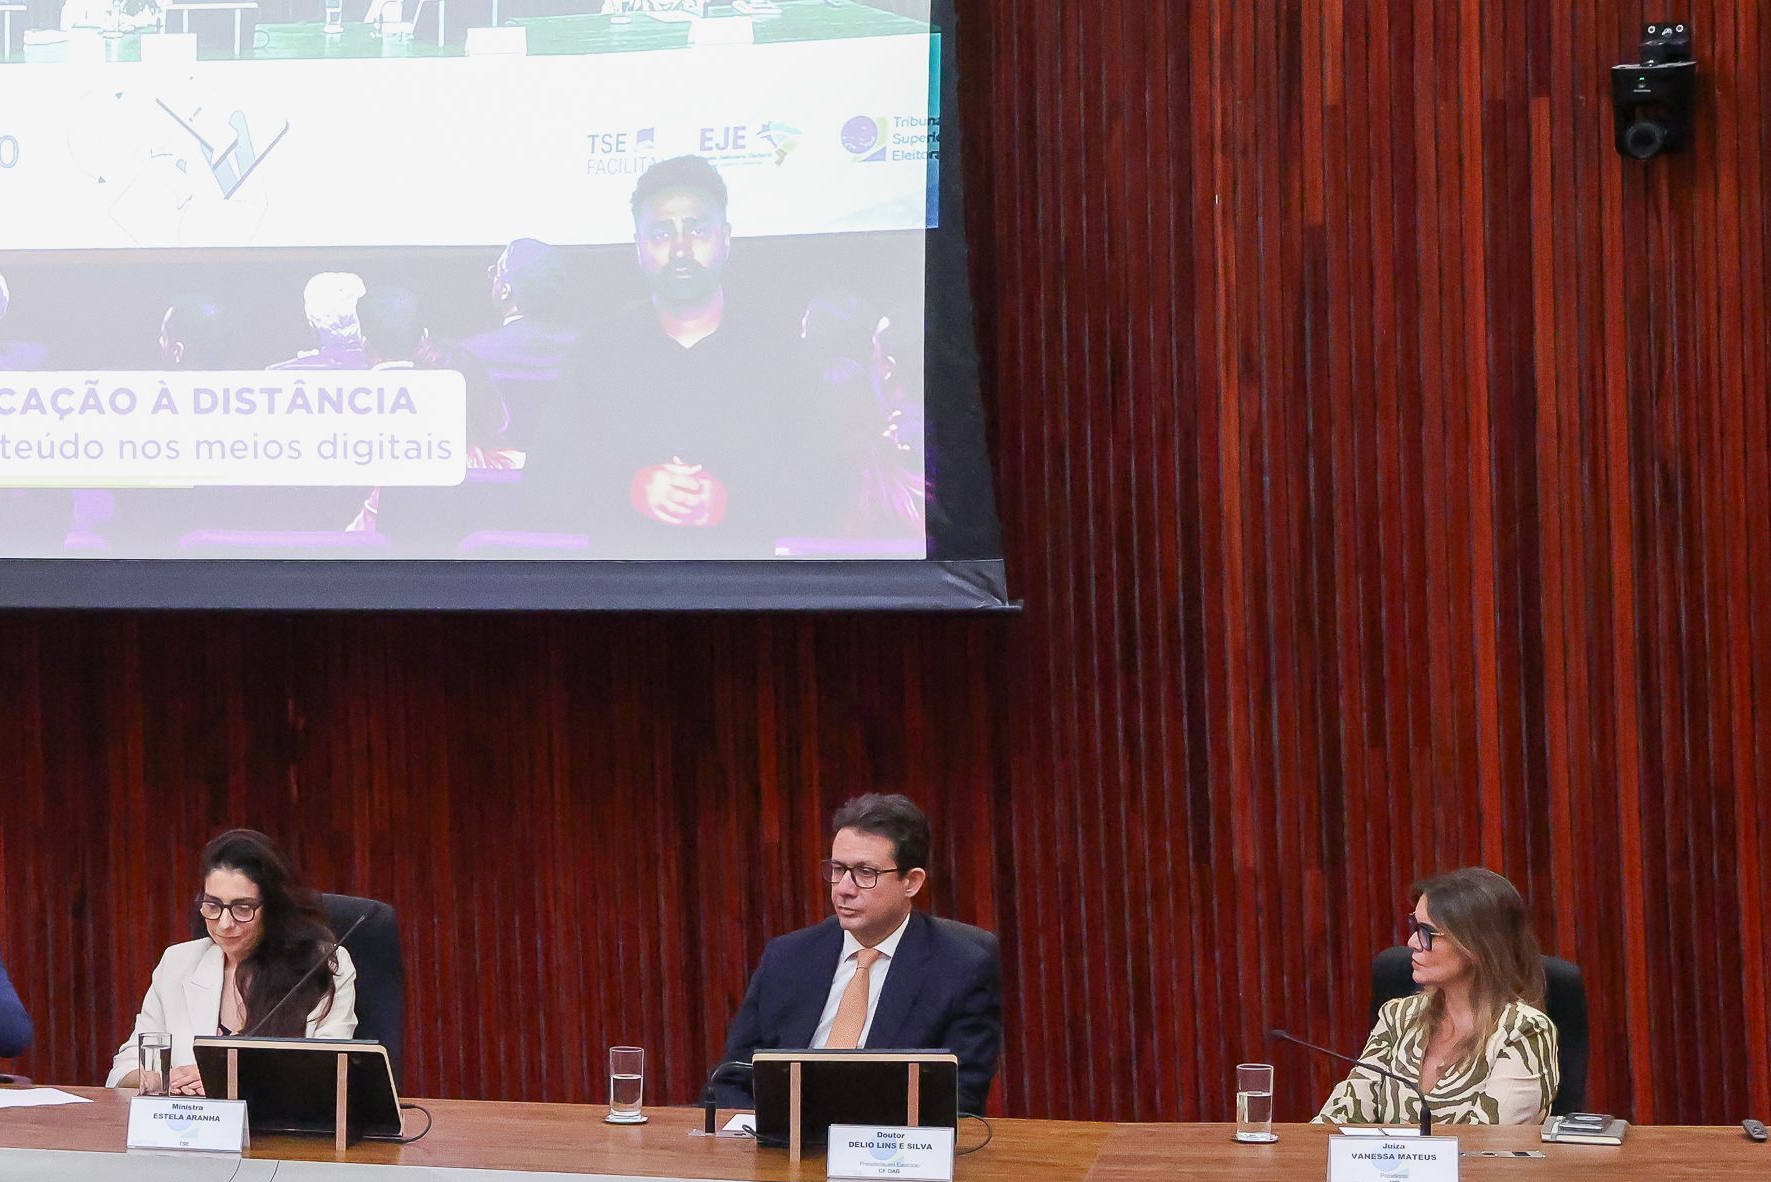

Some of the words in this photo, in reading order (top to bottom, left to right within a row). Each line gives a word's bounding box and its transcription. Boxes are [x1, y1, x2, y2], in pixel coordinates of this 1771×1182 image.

[588, 133, 627, 154] TSE
[700, 126, 746, 151] EJE
[151, 380, 178, 415] À
[194, 380, 417, 415] DISTÂNCIA
[119, 438, 180, 460] nos
[196, 433, 302, 460] meios
[318, 432, 452, 466] digitais
[172, 1103, 204, 1111] Ministra
[186, 1114, 220, 1122] ARANHA
